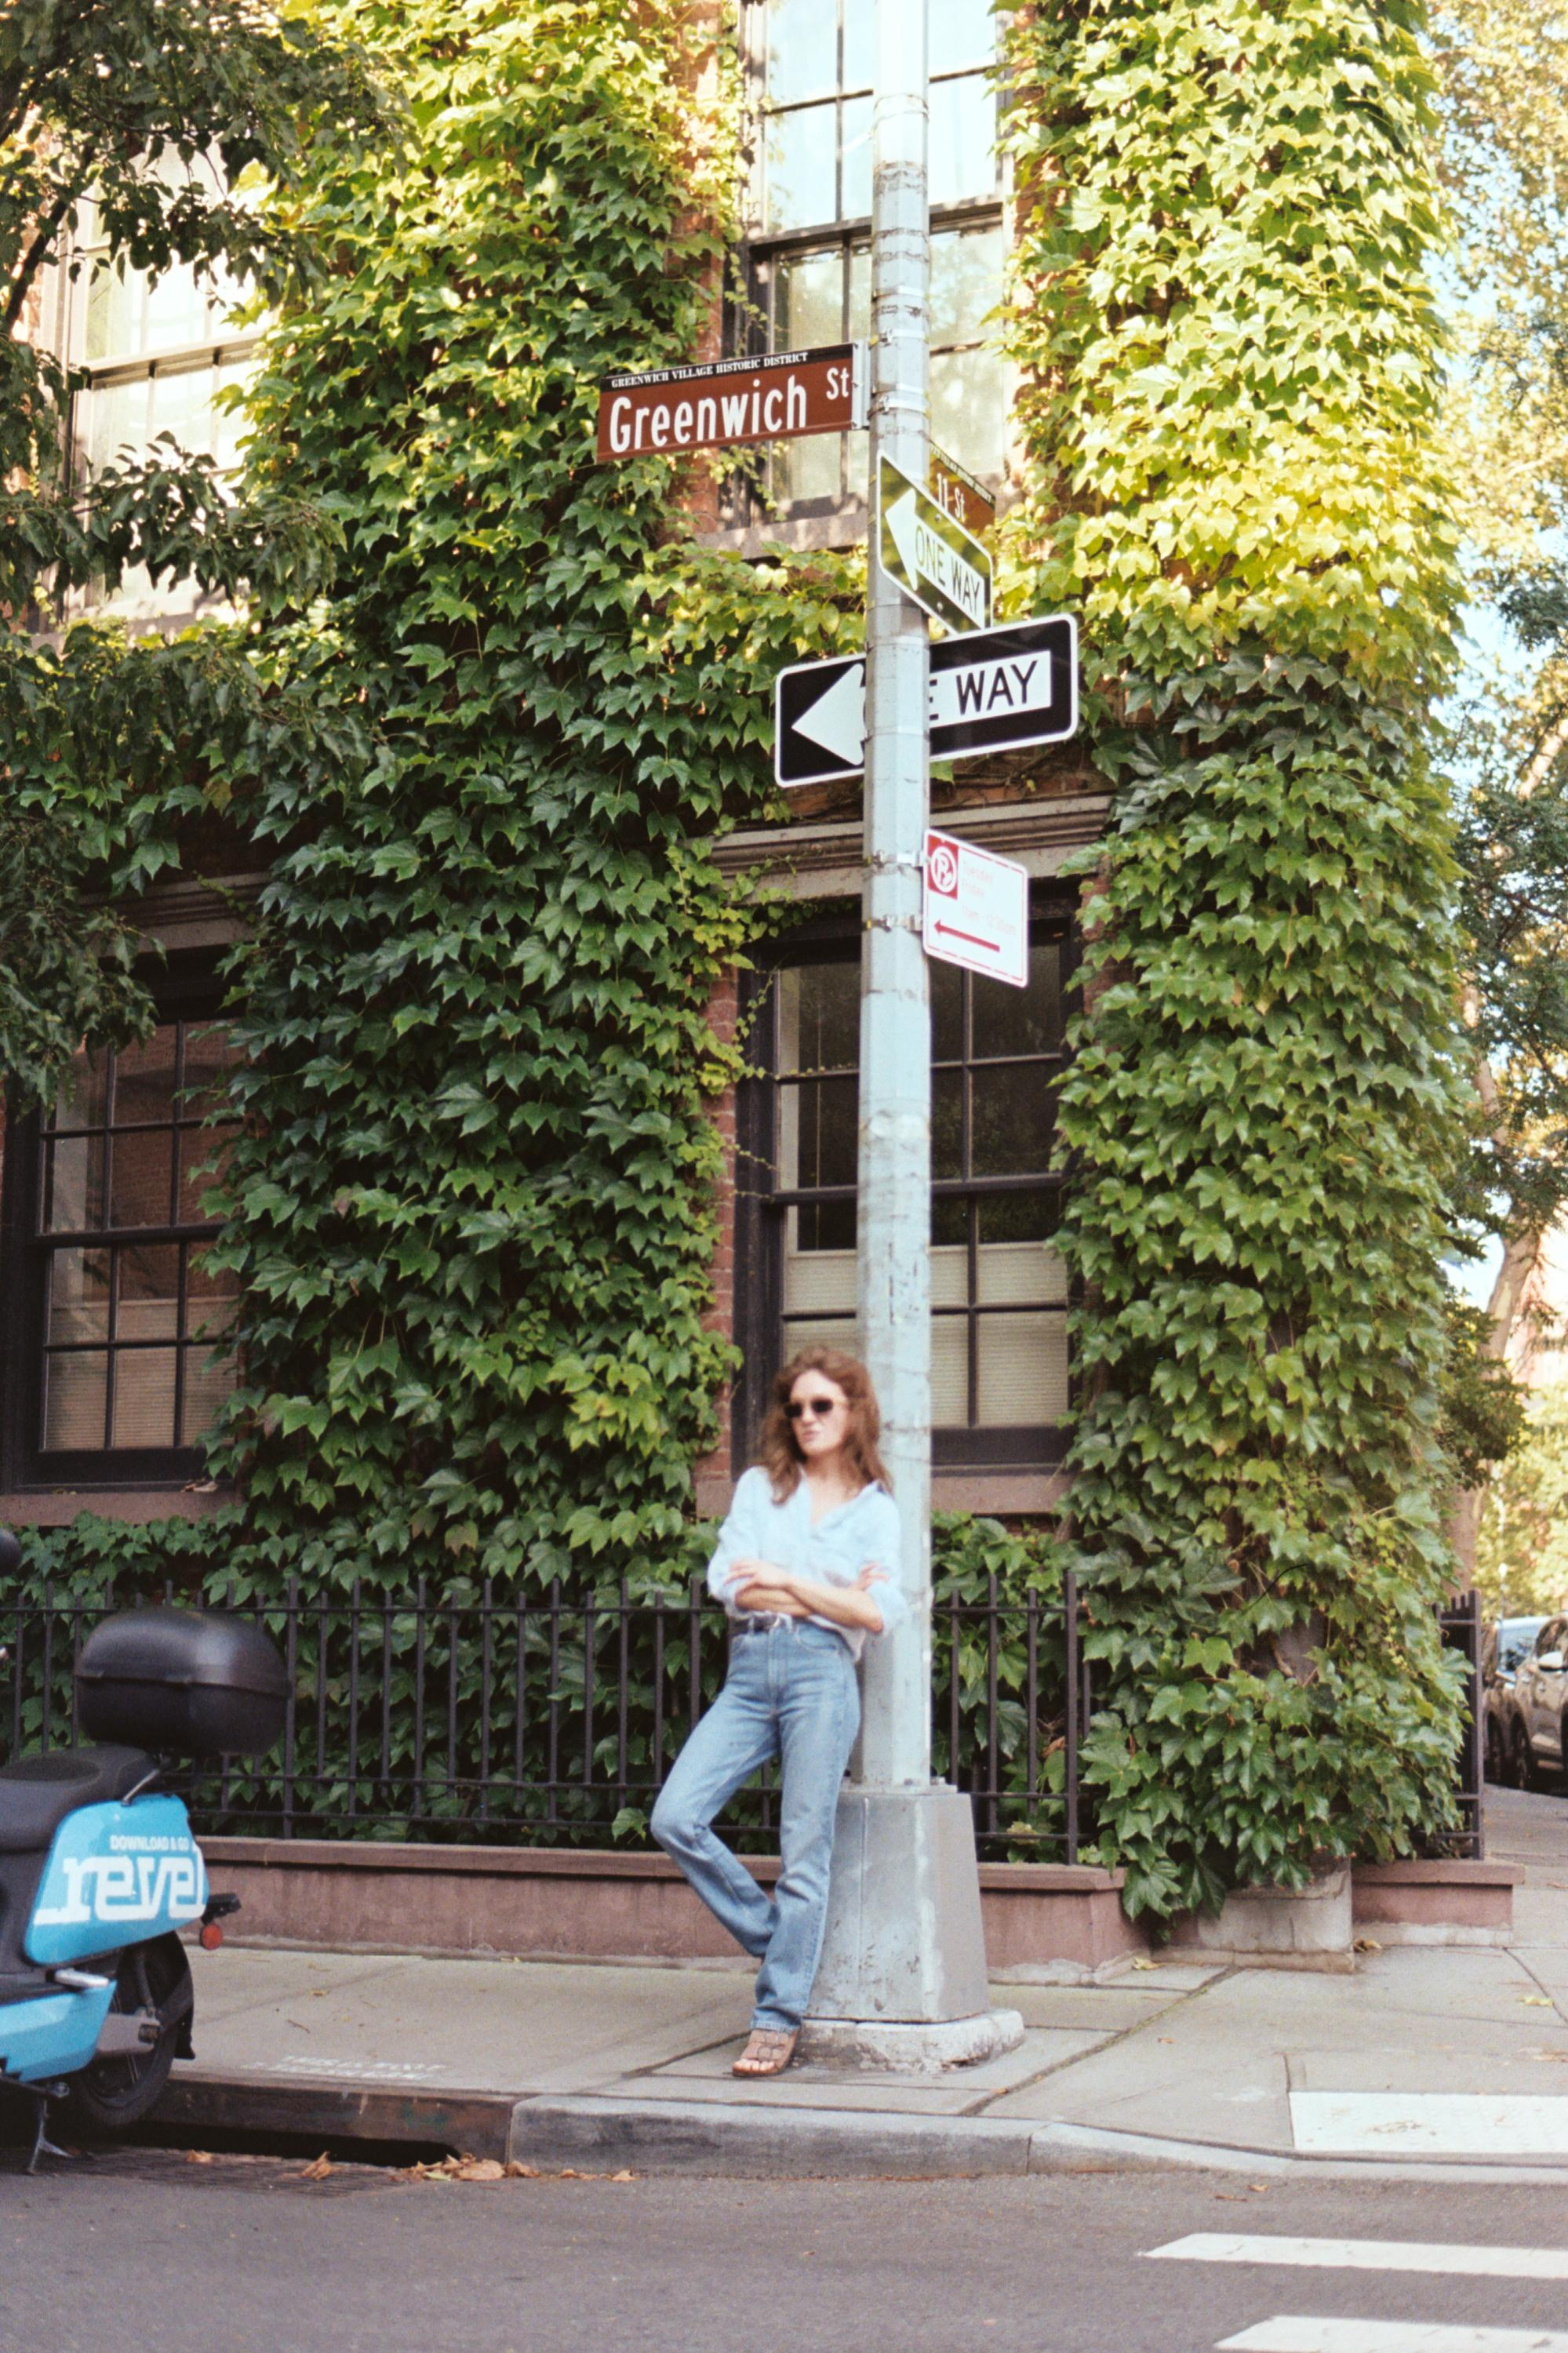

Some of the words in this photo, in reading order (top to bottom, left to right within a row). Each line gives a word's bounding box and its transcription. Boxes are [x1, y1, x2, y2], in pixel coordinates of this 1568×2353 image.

[611, 372, 668, 388] GREENWICH
[671, 365, 714, 380] VILLAGE
[716, 358, 761, 374] HISTORIC
[764, 352, 809, 367] DISTRICT
[609, 375, 807, 453] Greenwich
[826, 367, 849, 400] St
[955, 486, 965, 523] St
[915, 525, 946, 586] ONE
[951, 556, 981, 618] WAY
[956, 660, 1039, 715] WAY
[109, 1835, 169, 1851] DOWNLOAD
[33, 1838, 207, 1926] revel
